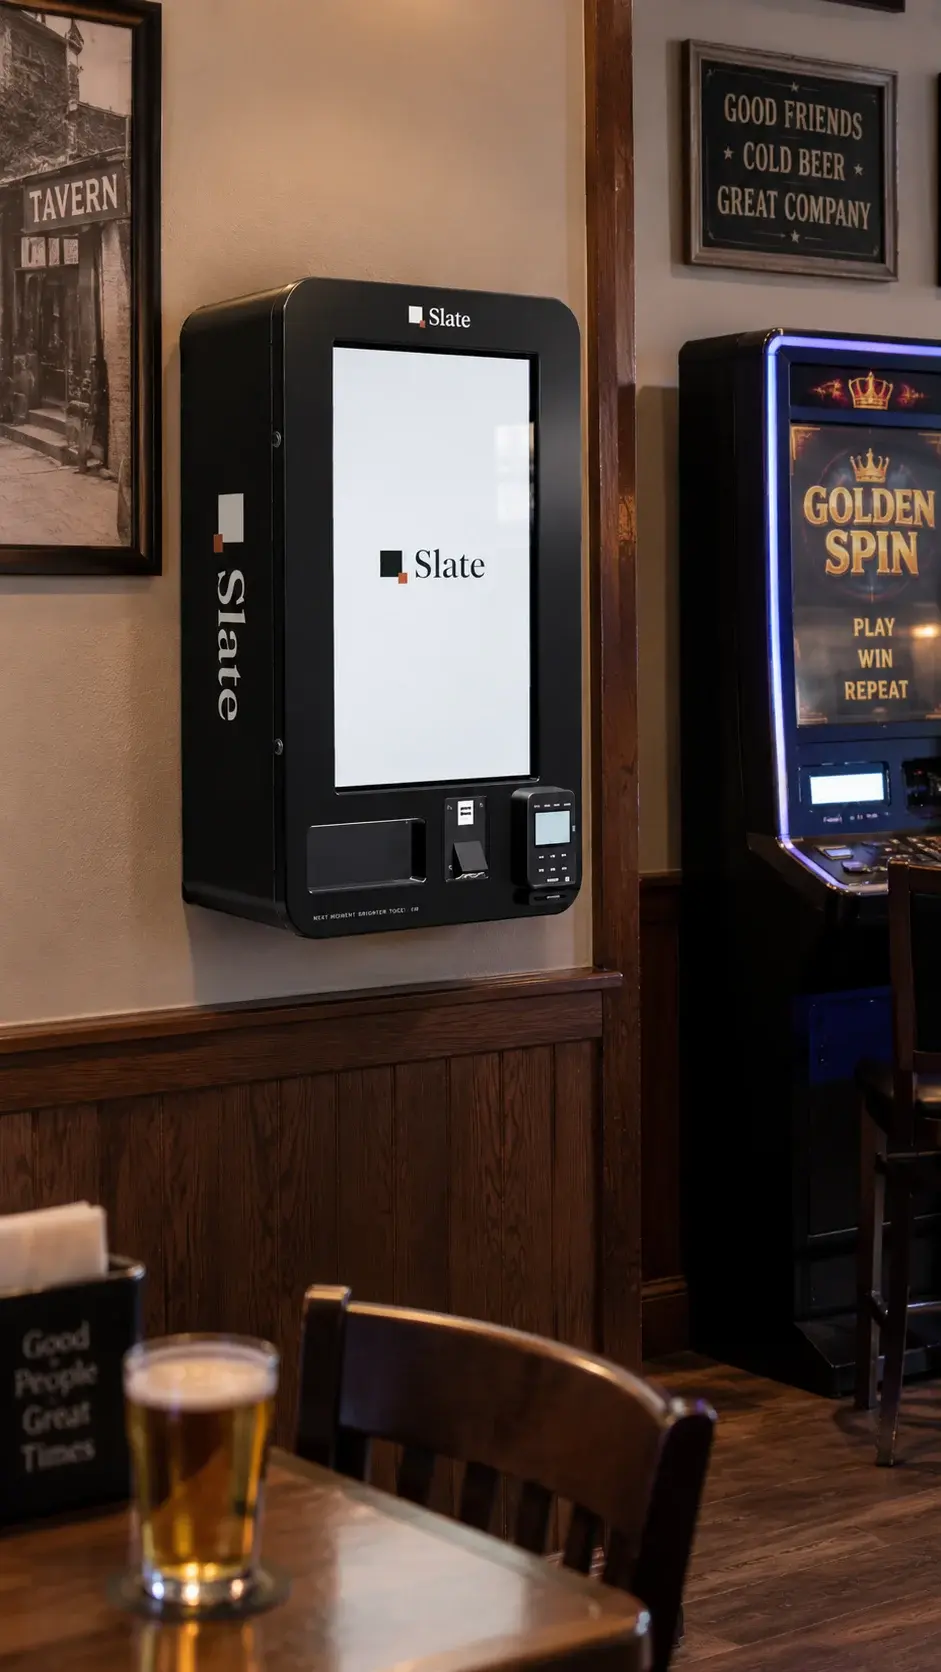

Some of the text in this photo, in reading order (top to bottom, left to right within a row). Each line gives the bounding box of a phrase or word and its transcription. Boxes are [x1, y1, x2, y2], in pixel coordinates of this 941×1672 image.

[724, 93, 863, 140] GOOD FRIENDS
[743, 141, 846, 181] COLD BEER
[29, 174, 118, 223] TAVERN
[717, 185, 872, 230] GREAT COMPANY
[429, 307, 471, 328] Slate
[803, 485, 936, 529] GOLDEN
[415, 548, 485, 579] Slate
[825, 528, 920, 577] SPIN
[217, 569, 247, 721] Slate
[853, 617, 896, 637] PLAY
[857, 648, 893, 669] WIN
[844, 679, 909, 700] REPEAT
